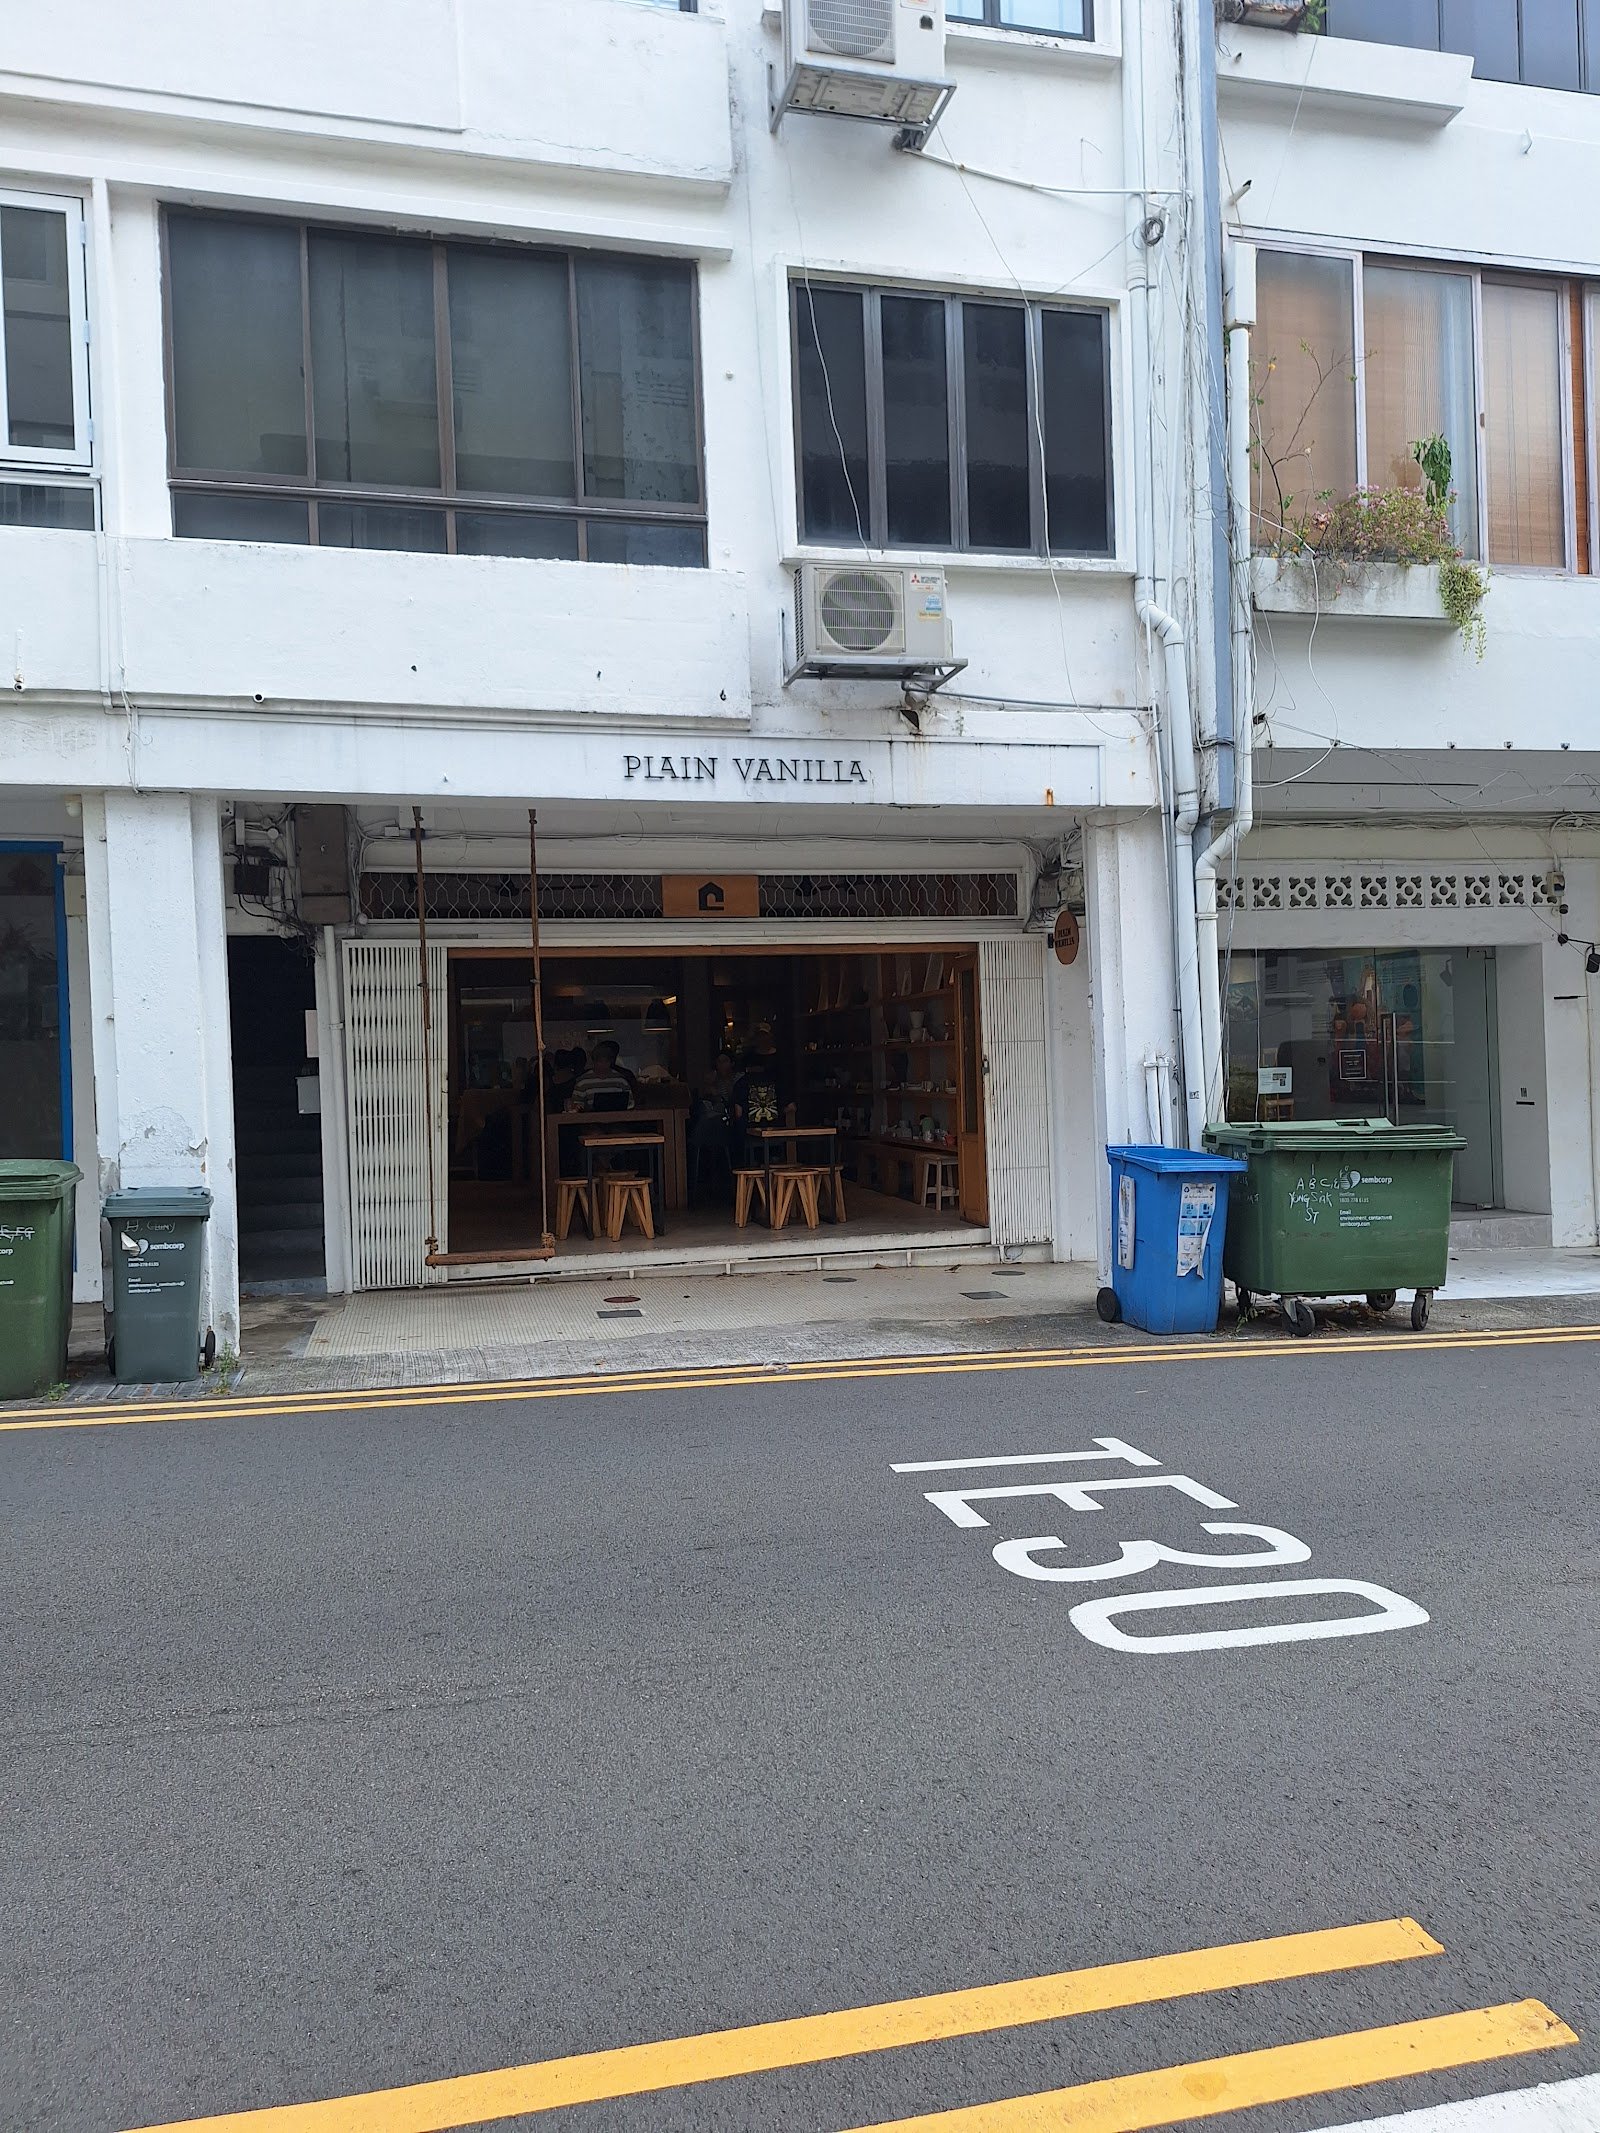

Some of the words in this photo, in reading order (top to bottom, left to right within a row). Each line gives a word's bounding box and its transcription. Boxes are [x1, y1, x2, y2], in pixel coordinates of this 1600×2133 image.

[623, 755, 718, 780] PLAIN
[732, 758, 868, 782] VANILLA
[1361, 1176, 1393, 1185] sembcorp
[149, 1242, 186, 1251] sembcorp
